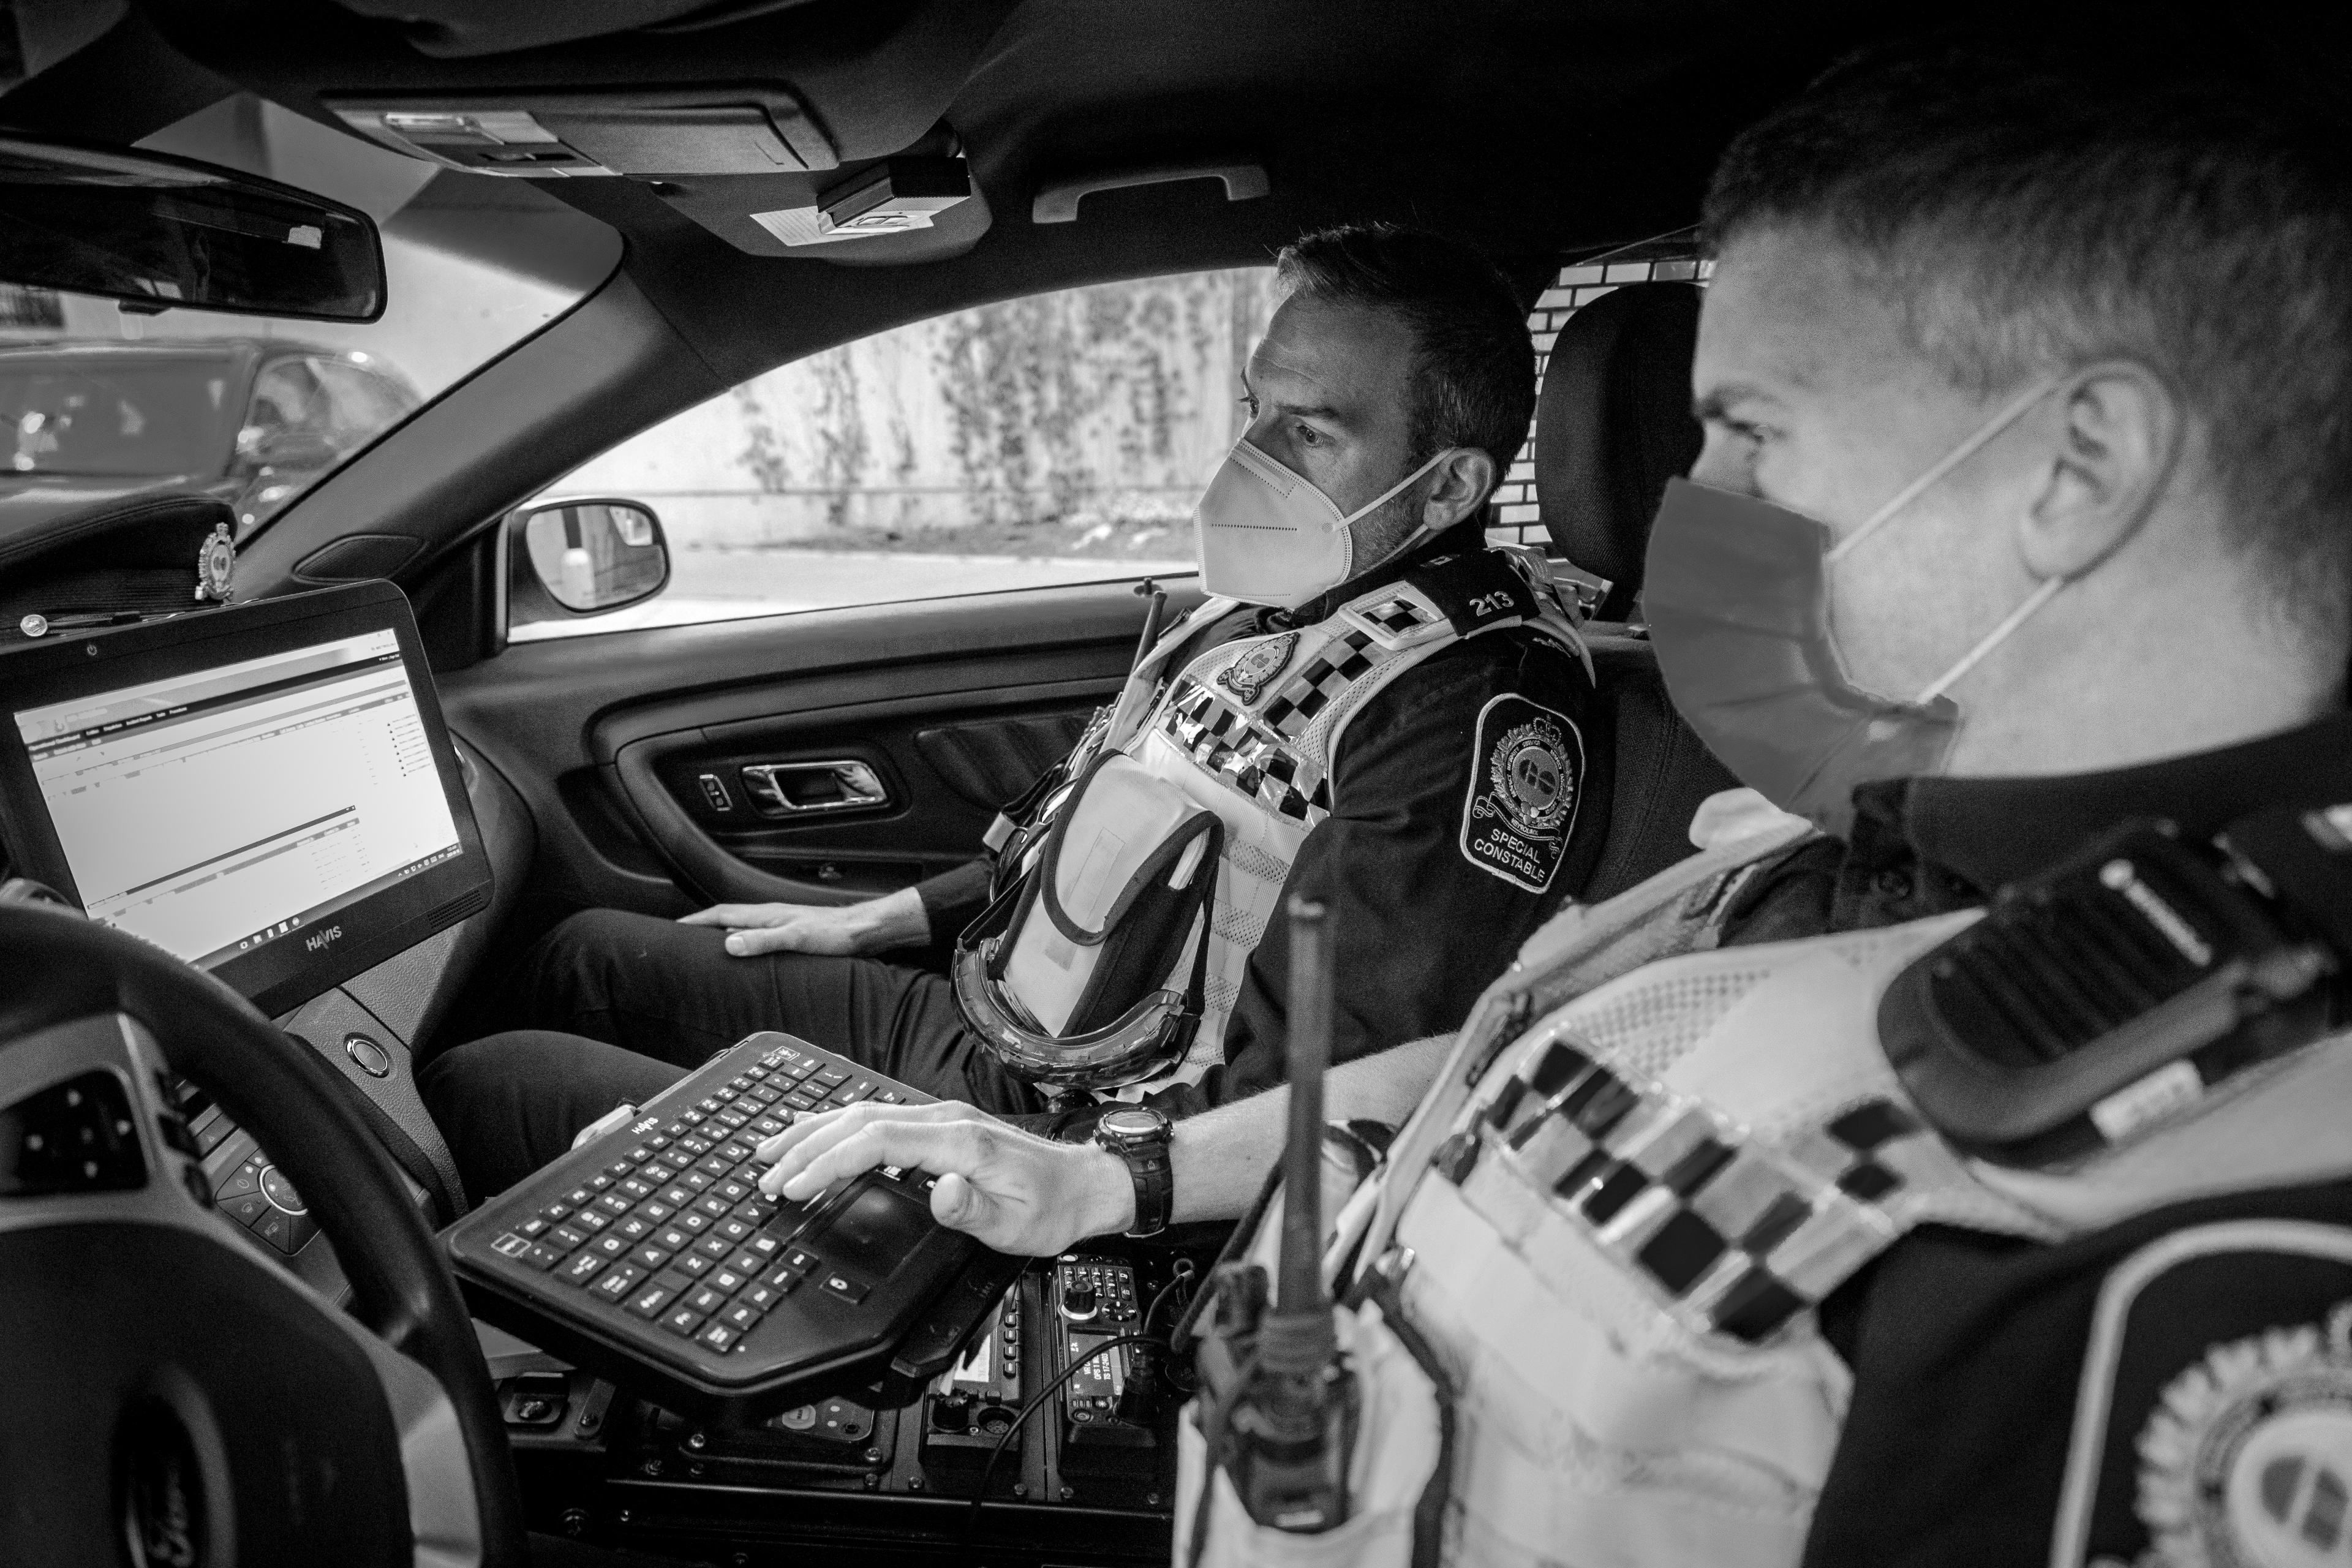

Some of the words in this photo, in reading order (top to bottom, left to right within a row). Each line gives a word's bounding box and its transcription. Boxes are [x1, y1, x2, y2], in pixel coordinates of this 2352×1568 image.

[1469, 592, 1514, 617] 213
[1491, 828, 1540, 864] SPECIAL
[1474, 839, 1545, 883] CONSTABLE
[306, 925, 342, 952] HAVIS
[631, 1117, 658, 1134] HAVIS
[1093, 1368, 1102, 1380] OPS
[1102, 1352, 1110, 1372] 17-2403
